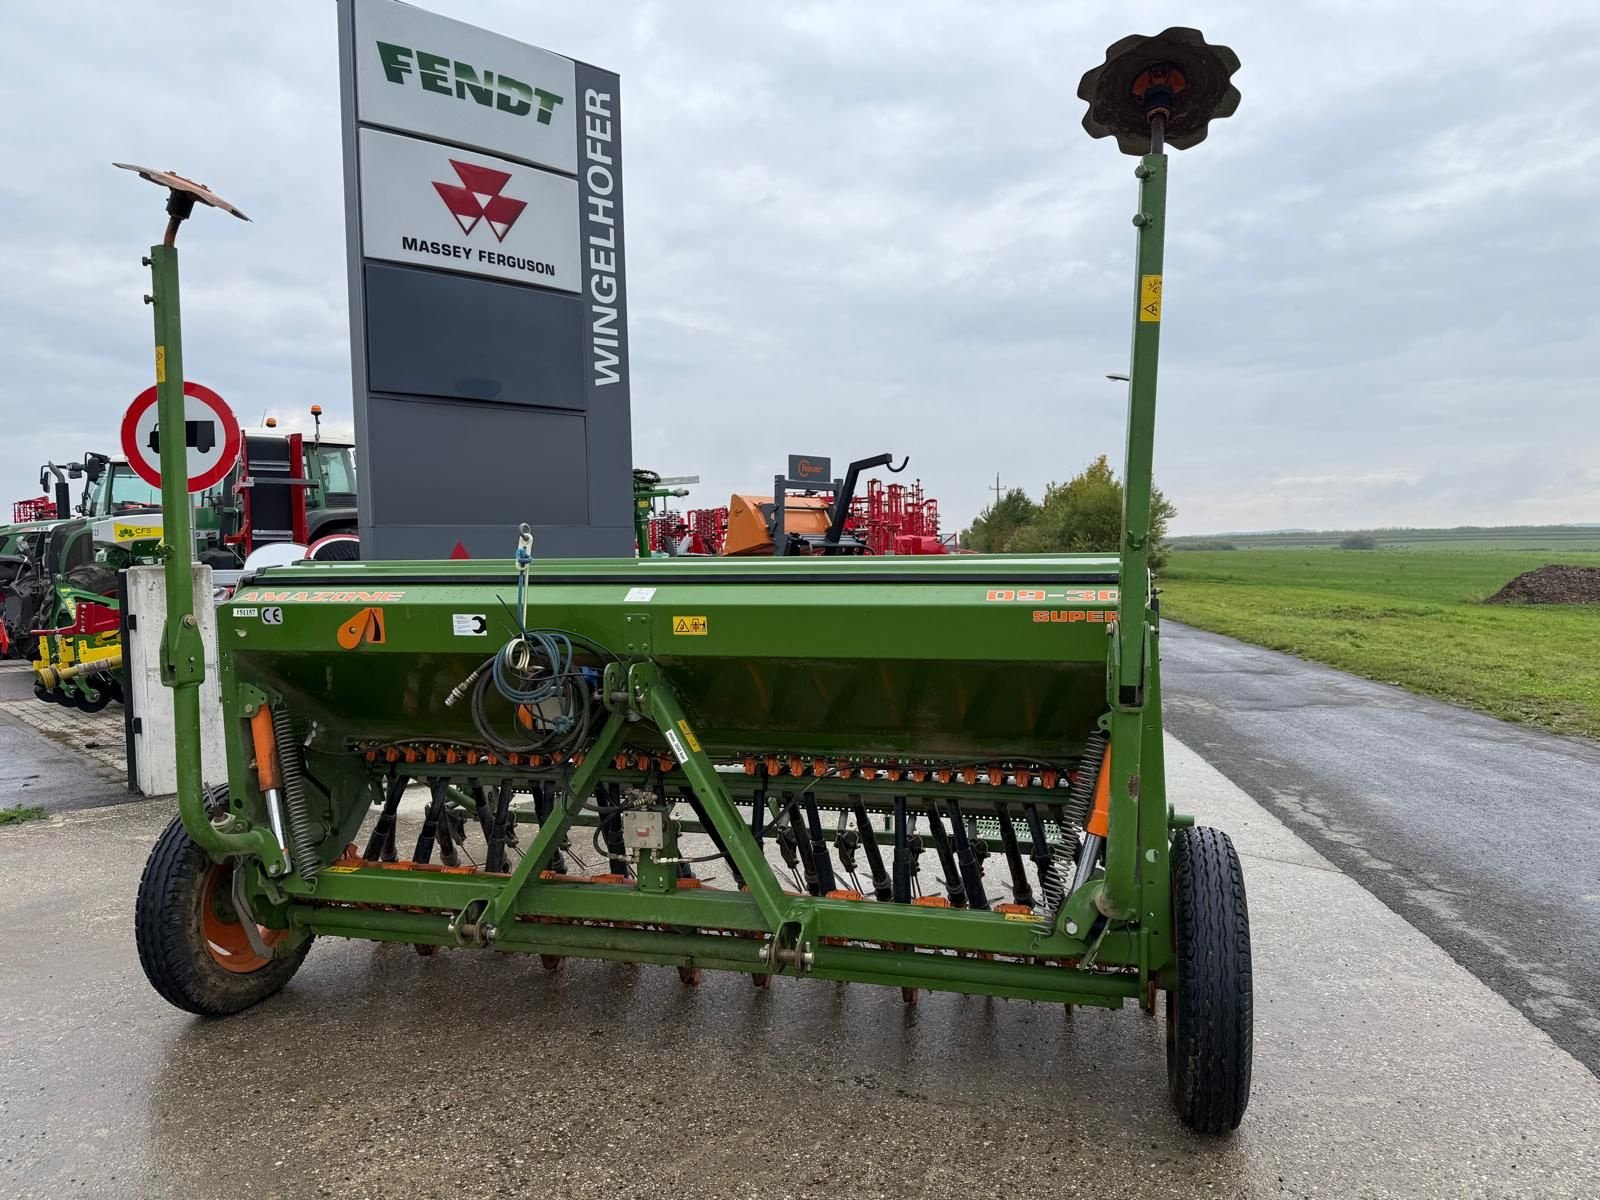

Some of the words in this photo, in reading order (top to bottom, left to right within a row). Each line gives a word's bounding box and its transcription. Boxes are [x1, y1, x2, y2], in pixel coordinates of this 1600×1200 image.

[376, 40, 564, 126] FENDT
[402, 236, 472, 260] MASSEY
[478, 249, 555, 276] FERGUSON
[585, 88, 621, 386] WINGELHOFER
[237, 591, 405, 601] AMAZONE
[1032, 610, 1119, 622] SUPER
